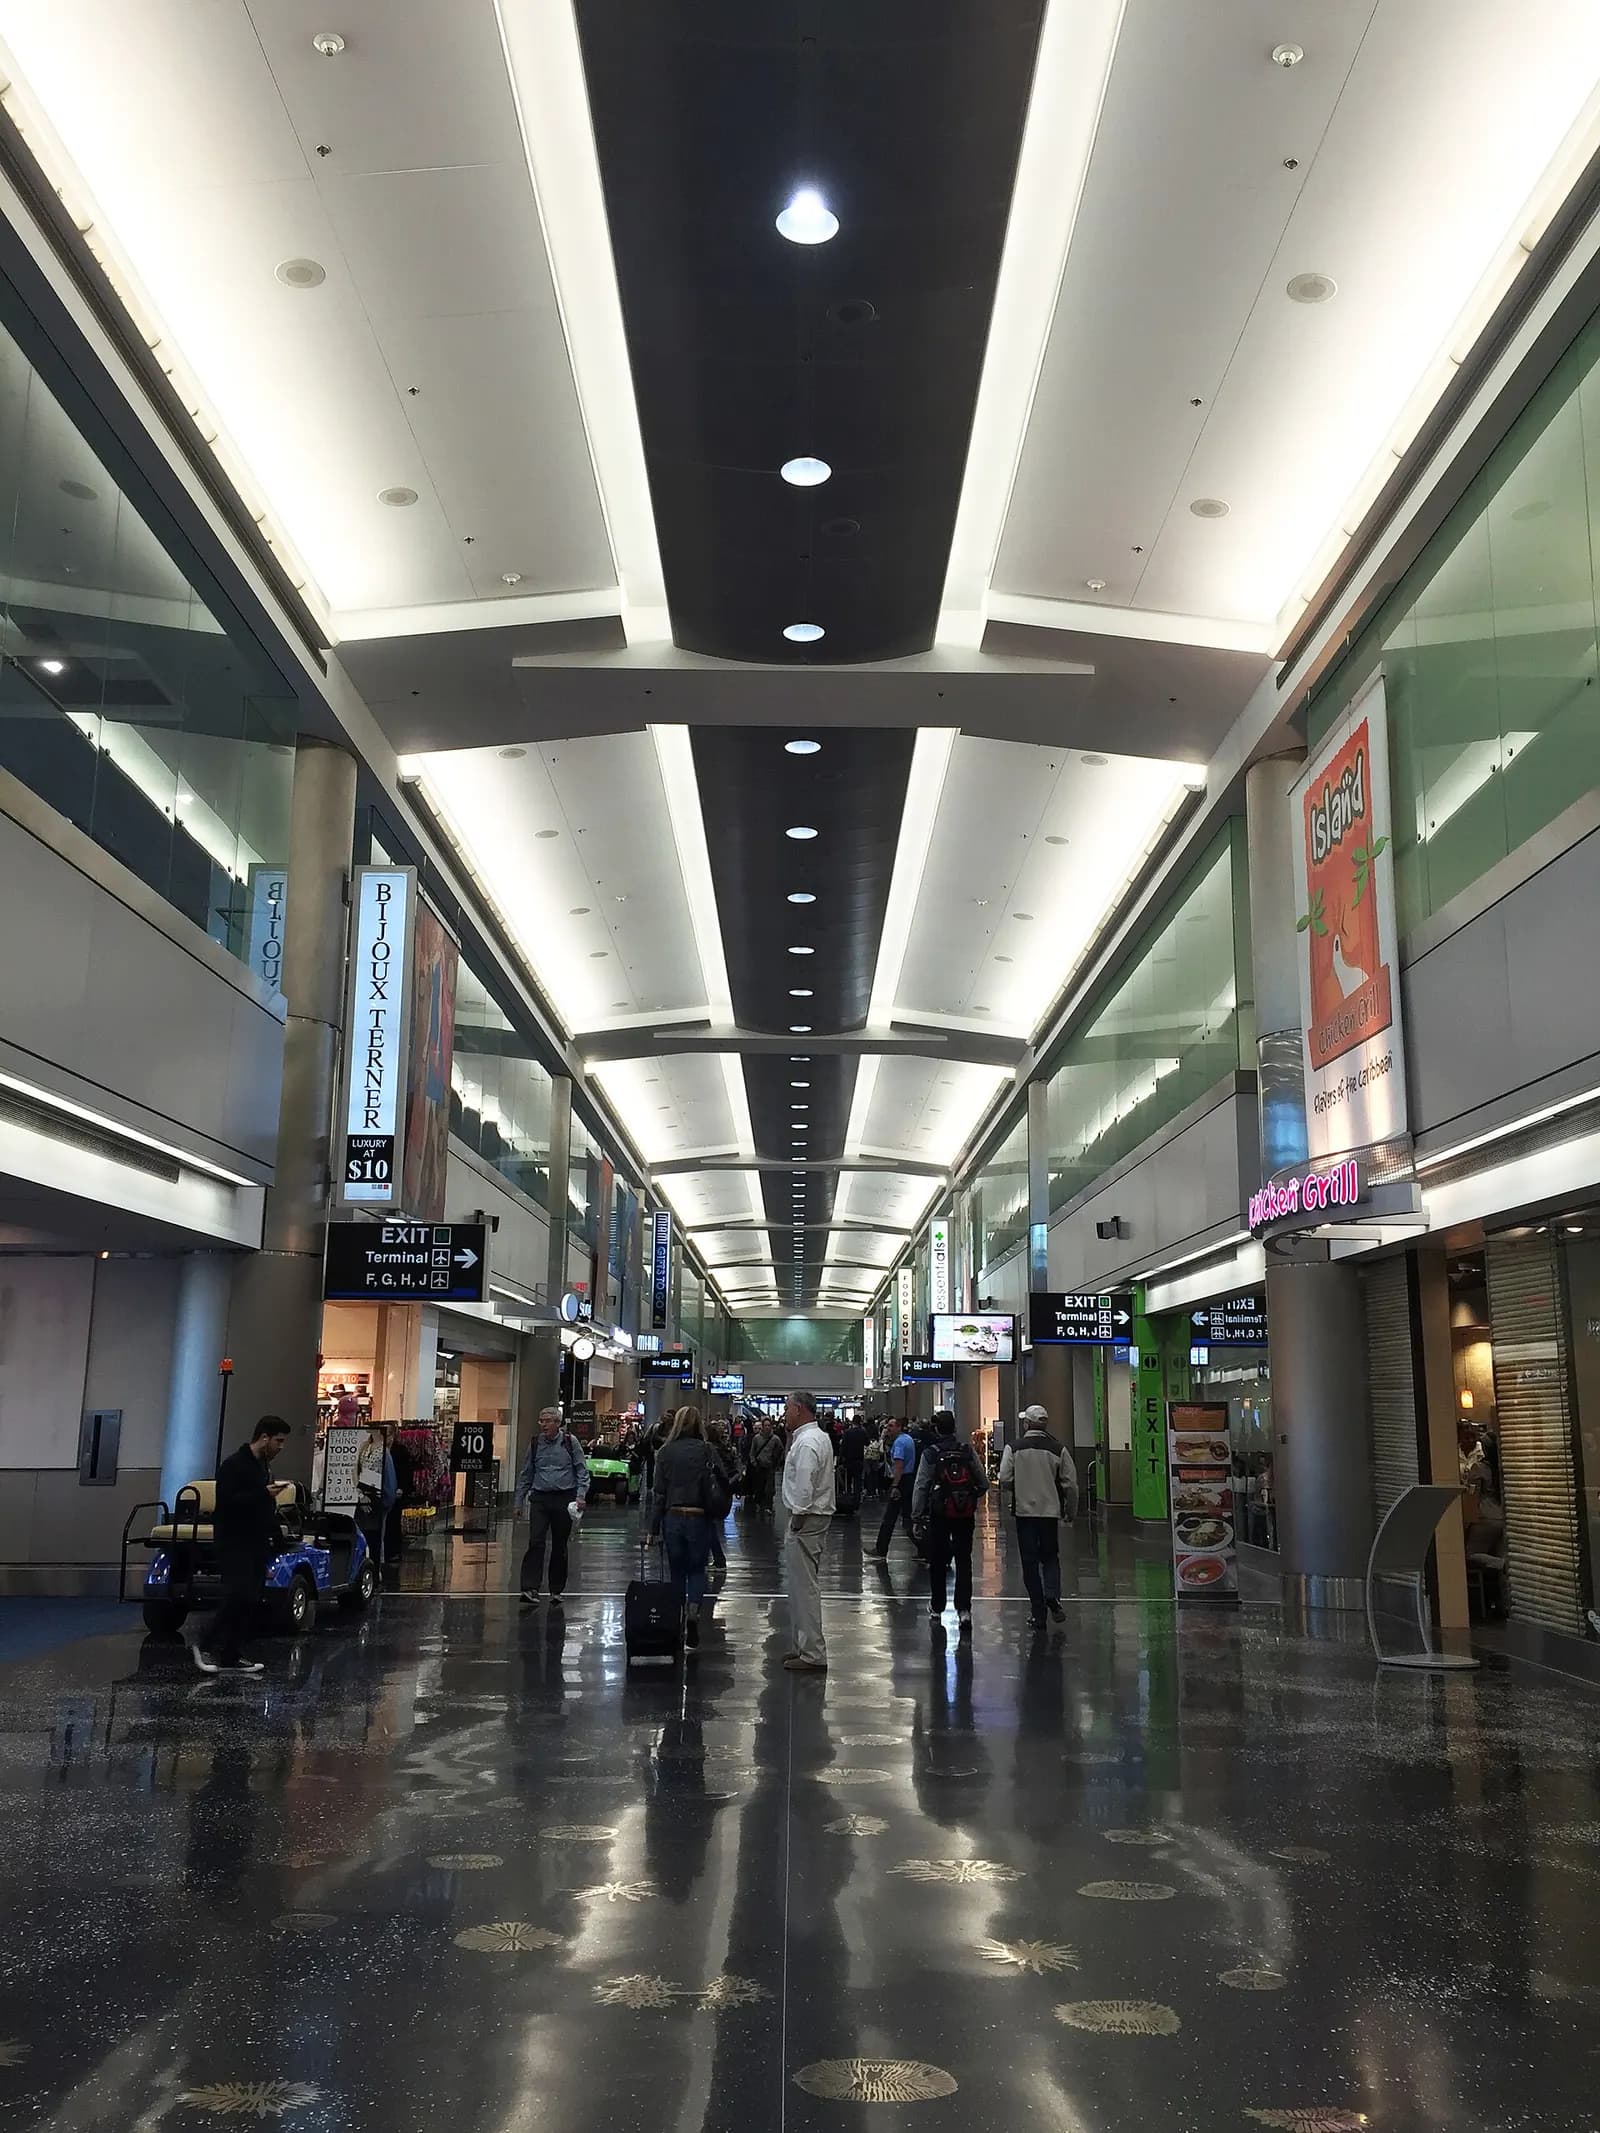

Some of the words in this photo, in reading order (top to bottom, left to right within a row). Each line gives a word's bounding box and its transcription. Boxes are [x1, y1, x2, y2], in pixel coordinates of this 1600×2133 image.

[369, 883, 391, 1000] BIJOUX
[1319, 1009, 1355, 1054] Chicken
[1358, 983, 1380, 1028] Grill
[363, 1009, 387, 1129] TERNER
[352, 1139, 387, 1148] LUXURY
[363, 1149, 375, 1158] AT
[348, 1159, 388, 1180] $10
[1302, 1160, 1358, 1211] Grill
[381, 1227, 429, 1244] EXIT
[656, 1214, 668, 1245] MIAMI
[365, 1250, 428, 1264] Terminal
[365, 1273, 378, 1287] F,
[381, 1273, 397, 1287] G,
[401, 1273, 416, 1287] H,
[419, 1273, 427, 1286] J
[656, 1276, 665, 1290] TO
[934, 1242, 946, 1310] essentials
[655, 1291, 665, 1309] GO
[1064, 1295, 1097, 1308] EXIT
[1054, 1311, 1098, 1321] Terminal
[1056, 1326, 1065, 1336] F,
[1066, 1326, 1078, 1336] G,
[1079, 1326, 1090, 1336] H,
[1091, 1326, 1098, 1336] J
[330, 1430, 359, 1438] EVERY
[464, 1426, 484, 1434] TODO
[1146, 1397, 1160, 1474] EXIT
[330, 1437, 358, 1445] THING
[461, 1435, 484, 1454] $10
[330, 1446, 357, 1454] TODO
